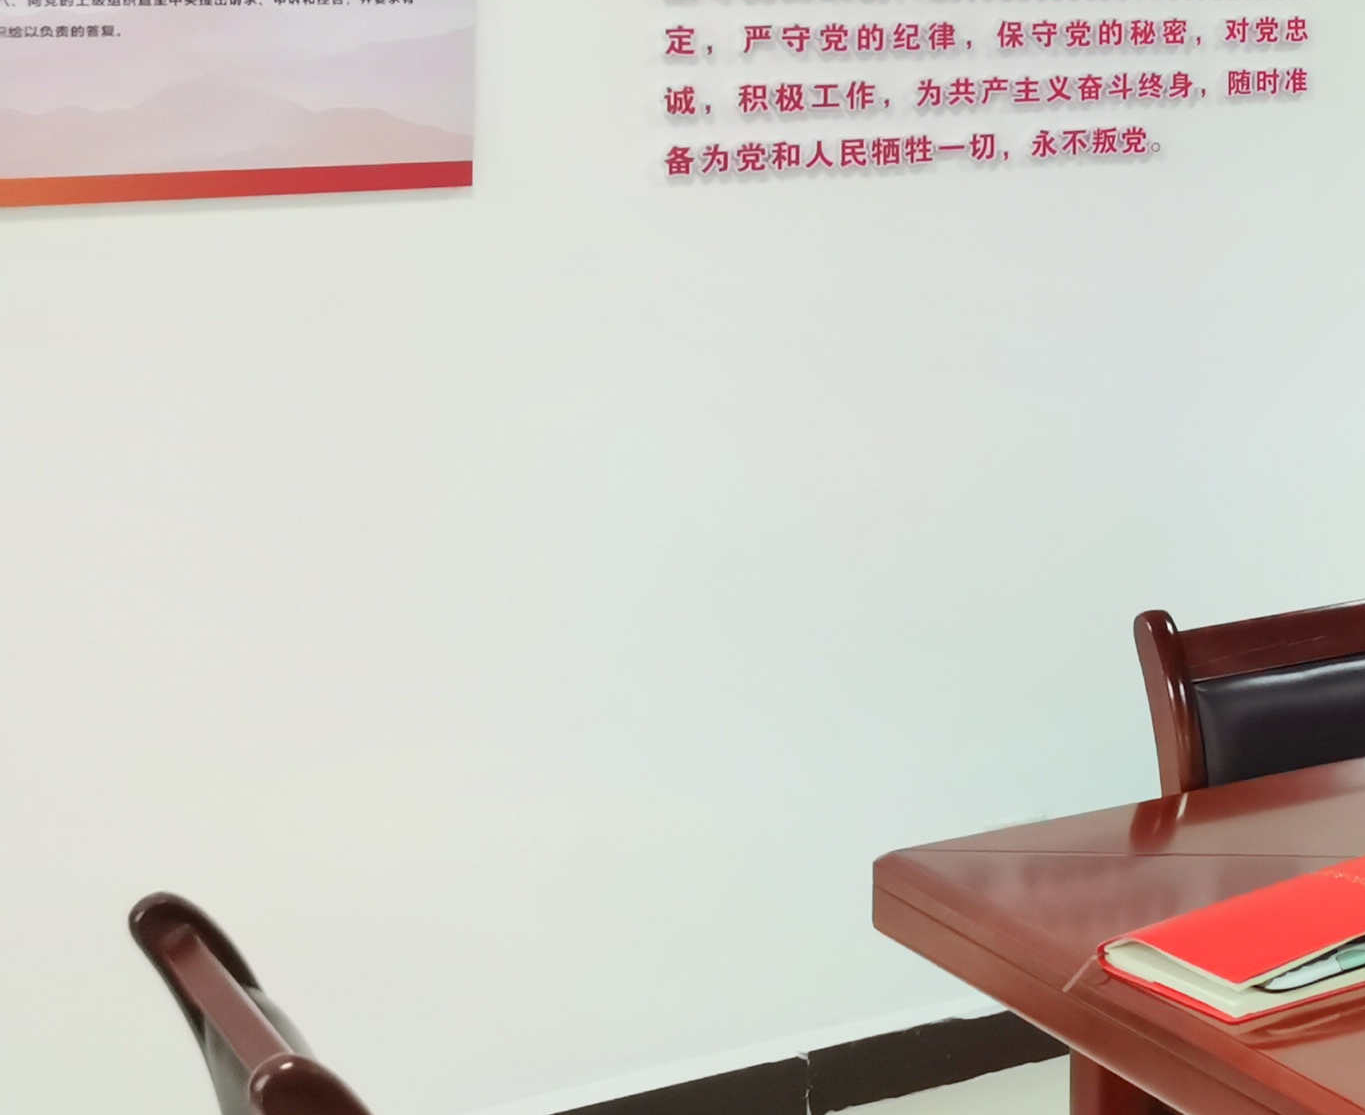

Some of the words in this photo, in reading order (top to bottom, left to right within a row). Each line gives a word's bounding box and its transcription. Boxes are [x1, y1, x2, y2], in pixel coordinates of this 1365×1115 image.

[664, 16, 1309, 57] 定，严守党的纪律，保守党的秘密，对党忠
[664, 66, 1308, 116] 诚，积极工作，为共产主义奋斗终身，随时准
[664, 126, 1163, 176] 备为党和人民牺牲一切，永不叛党。
